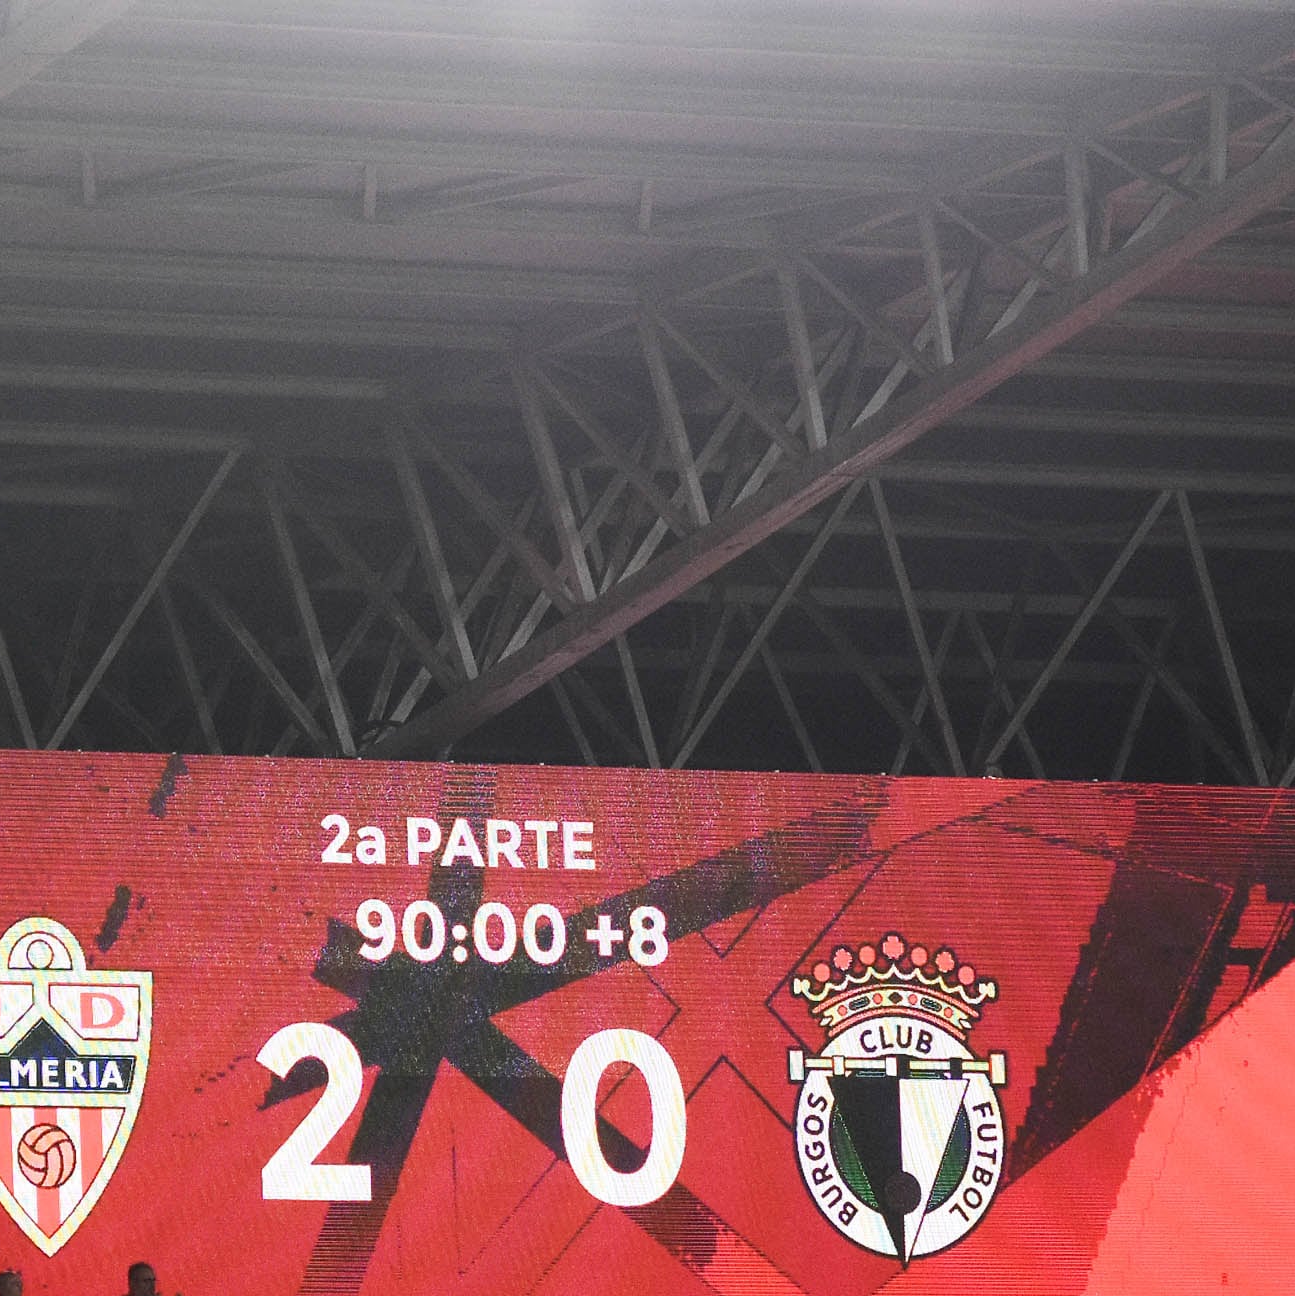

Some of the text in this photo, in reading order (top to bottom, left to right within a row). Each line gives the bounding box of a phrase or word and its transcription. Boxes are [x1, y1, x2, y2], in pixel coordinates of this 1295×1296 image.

[320, 814, 596, 870] 2a PARTE
[355, 898, 669, 967] 90:00 +8
[859, 1025, 934, 1054] CLUB
[255, 1021, 688, 1207] 2 0
[803, 1092, 859, 1227] BURGOS
[948, 1102, 998, 1222] FUTBOL
